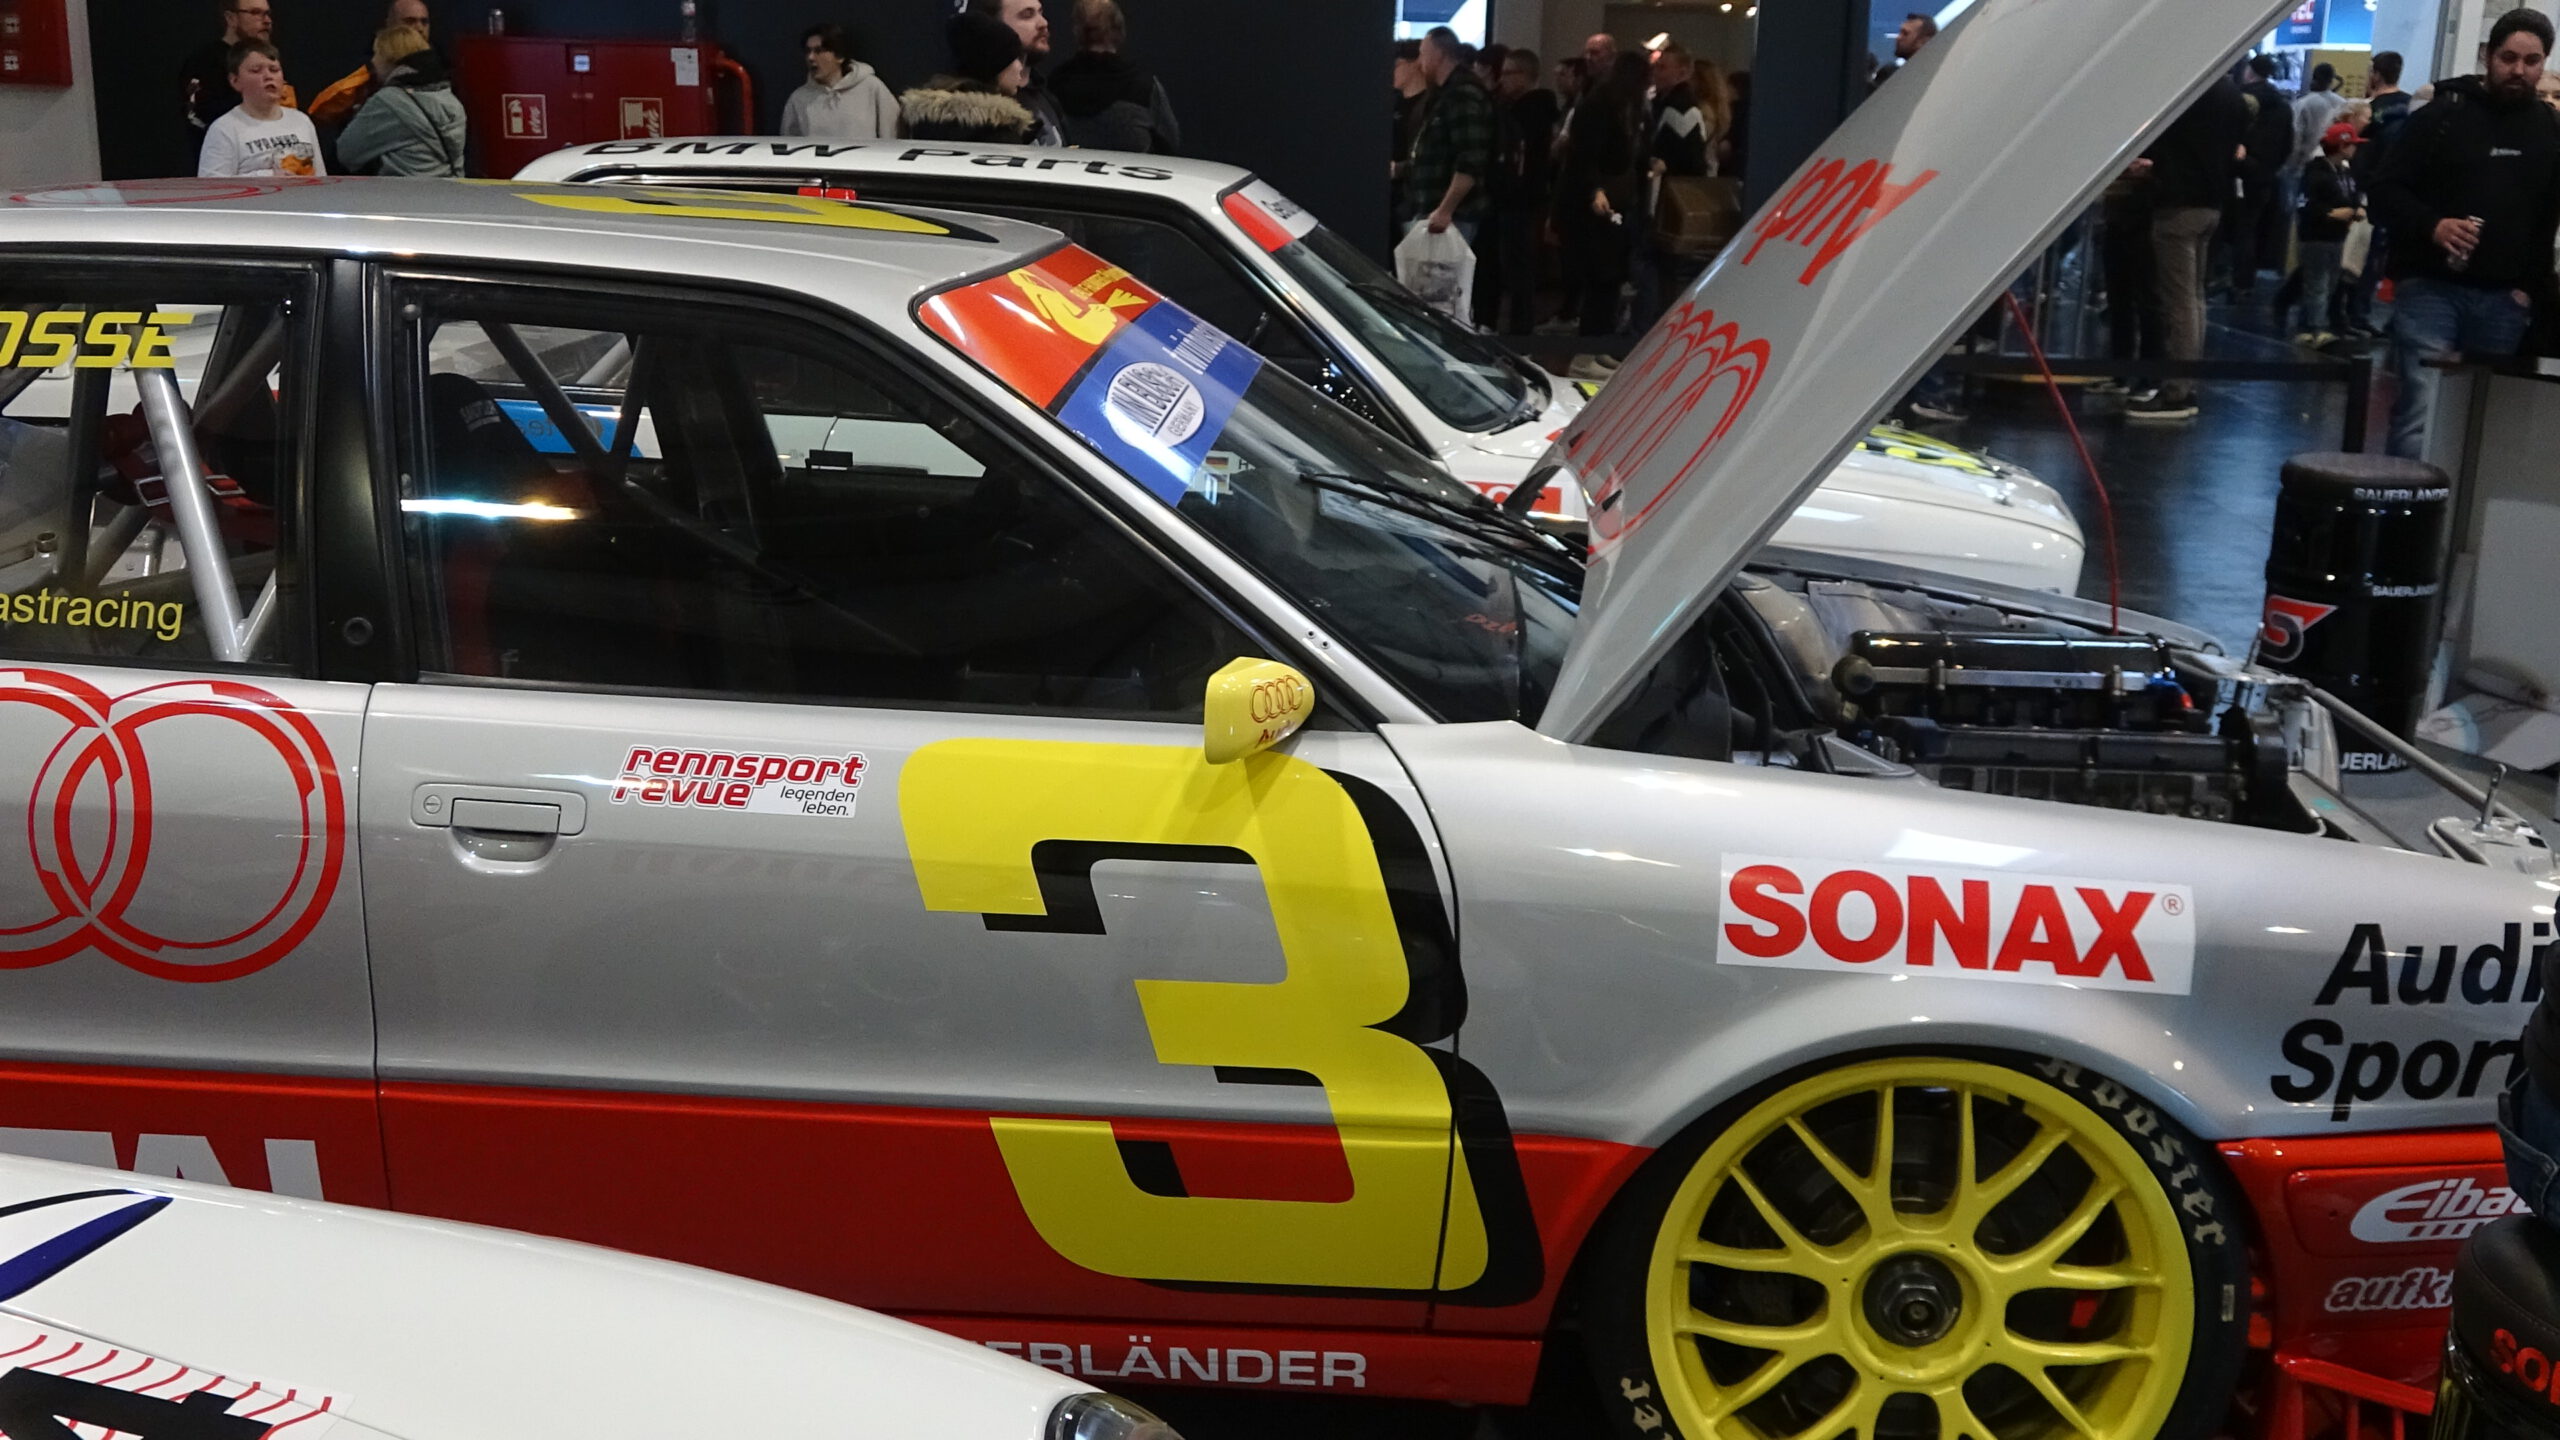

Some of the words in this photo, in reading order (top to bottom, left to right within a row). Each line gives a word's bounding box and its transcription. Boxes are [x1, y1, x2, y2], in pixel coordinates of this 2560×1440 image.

[583, 142, 868, 158] BMW
[898, 148, 1173, 181] Parts
[1741, 157, 1940, 287] Audi
[622, 747, 865, 787] rennsport
[613, 775, 753, 808] revue
[780, 784, 856, 803] legenden
[801, 801, 850, 817] leben.
[1723, 863, 2157, 984] SONAX
[2312, 921, 2551, 1007] Audi
[899, 737, 1510, 1300] 3
